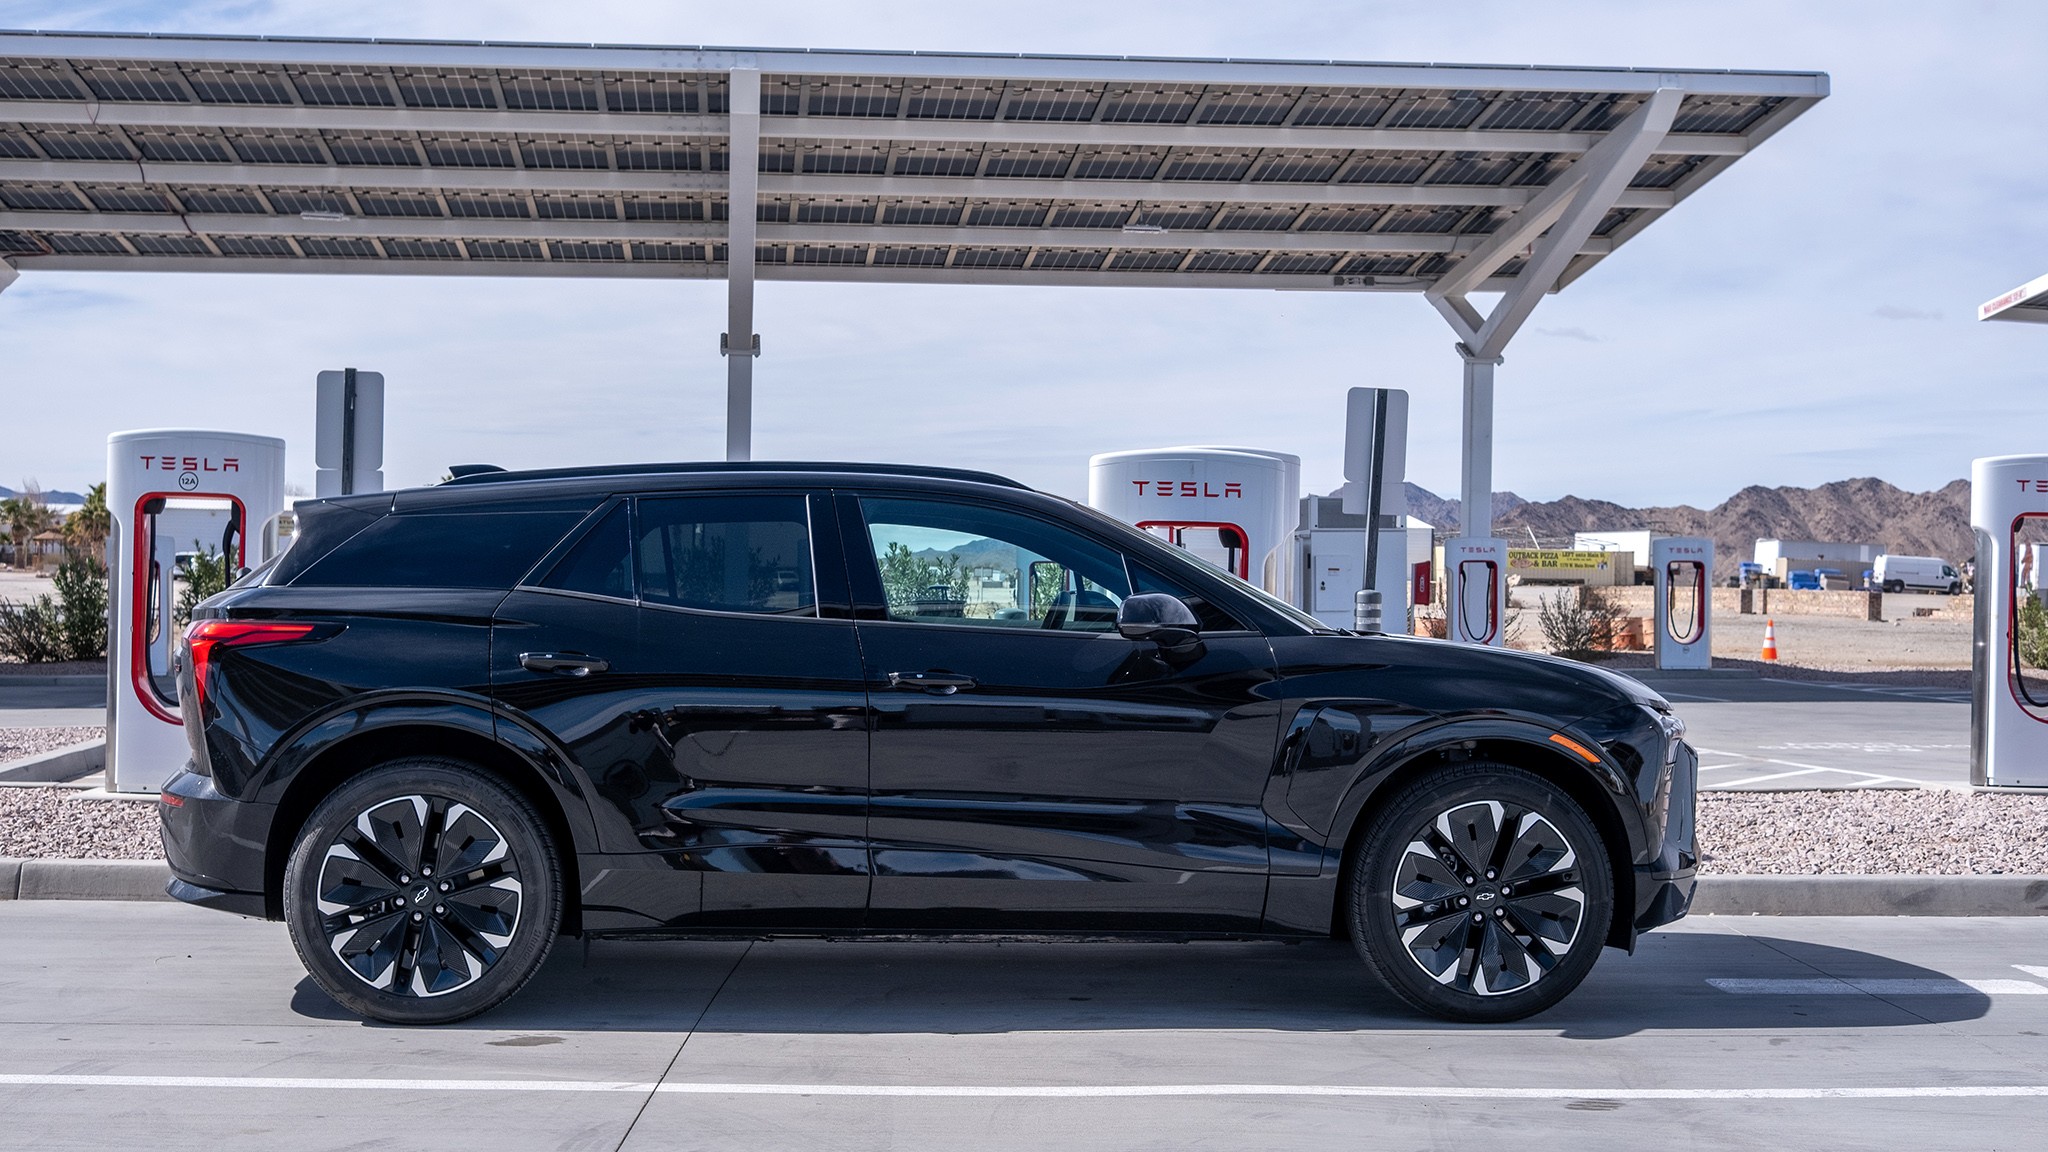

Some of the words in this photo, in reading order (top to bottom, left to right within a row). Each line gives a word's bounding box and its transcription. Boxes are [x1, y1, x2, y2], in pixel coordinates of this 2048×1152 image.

[140, 456, 239, 472] TESLA
[181, 478, 196, 486] 12A
[1132, 480, 1242, 499] TESLA
[1508, 551, 1539, 560] OUTBACK
[1540, 552, 1559, 560] PIZZA
